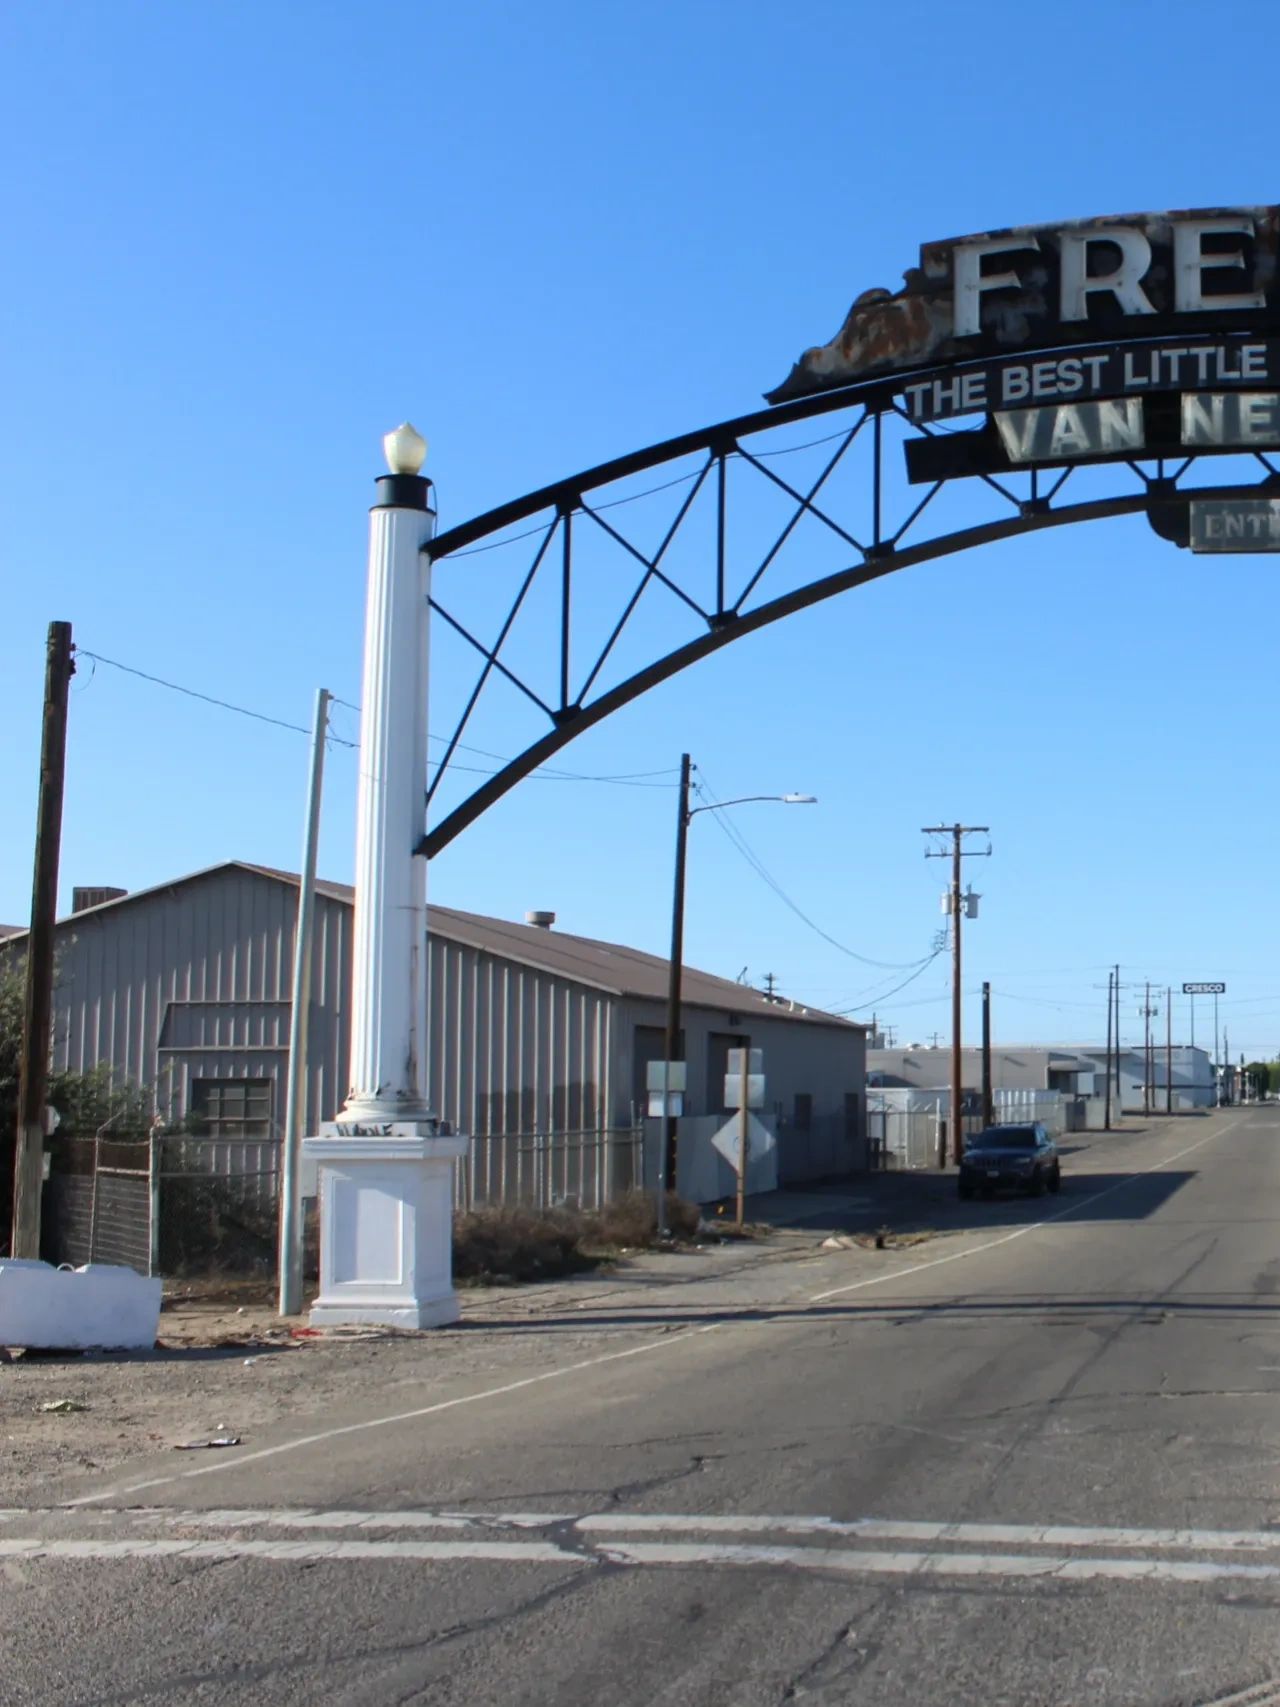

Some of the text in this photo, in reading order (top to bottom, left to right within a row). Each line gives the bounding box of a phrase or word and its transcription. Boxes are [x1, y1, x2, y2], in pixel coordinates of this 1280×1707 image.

[905, 372, 988, 418] THE
[1001, 355, 1109, 401] BEST
[1124, 343, 1268, 386] LITTLE
[994, 397, 1144, 462] VAN
